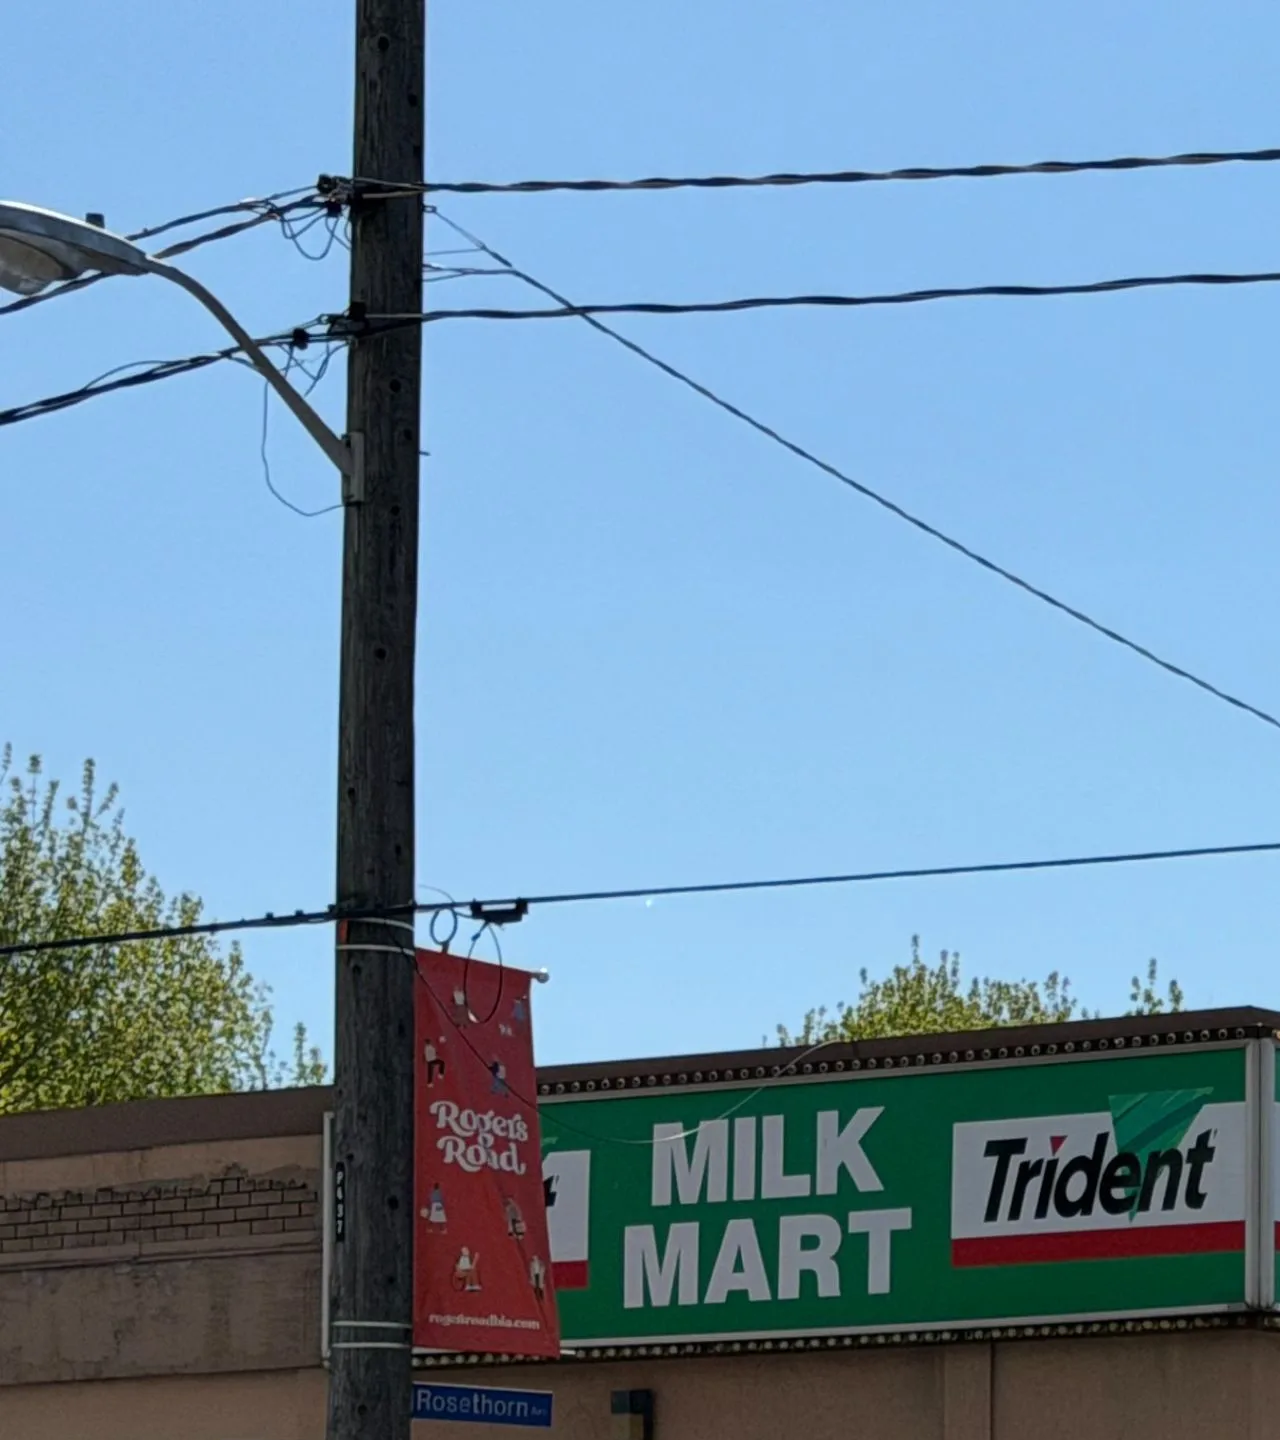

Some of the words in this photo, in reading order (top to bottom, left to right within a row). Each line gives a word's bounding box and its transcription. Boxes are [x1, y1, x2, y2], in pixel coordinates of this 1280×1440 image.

[429, 1100, 528, 1148] Rogers
[436, 1136, 527, 1176] Road
[650, 1105, 885, 1206] MILK
[982, 1130, 1216, 1223] Trident
[623, 1207, 912, 1309] MART
[416, 1389, 529, 1417] Rosethorn
